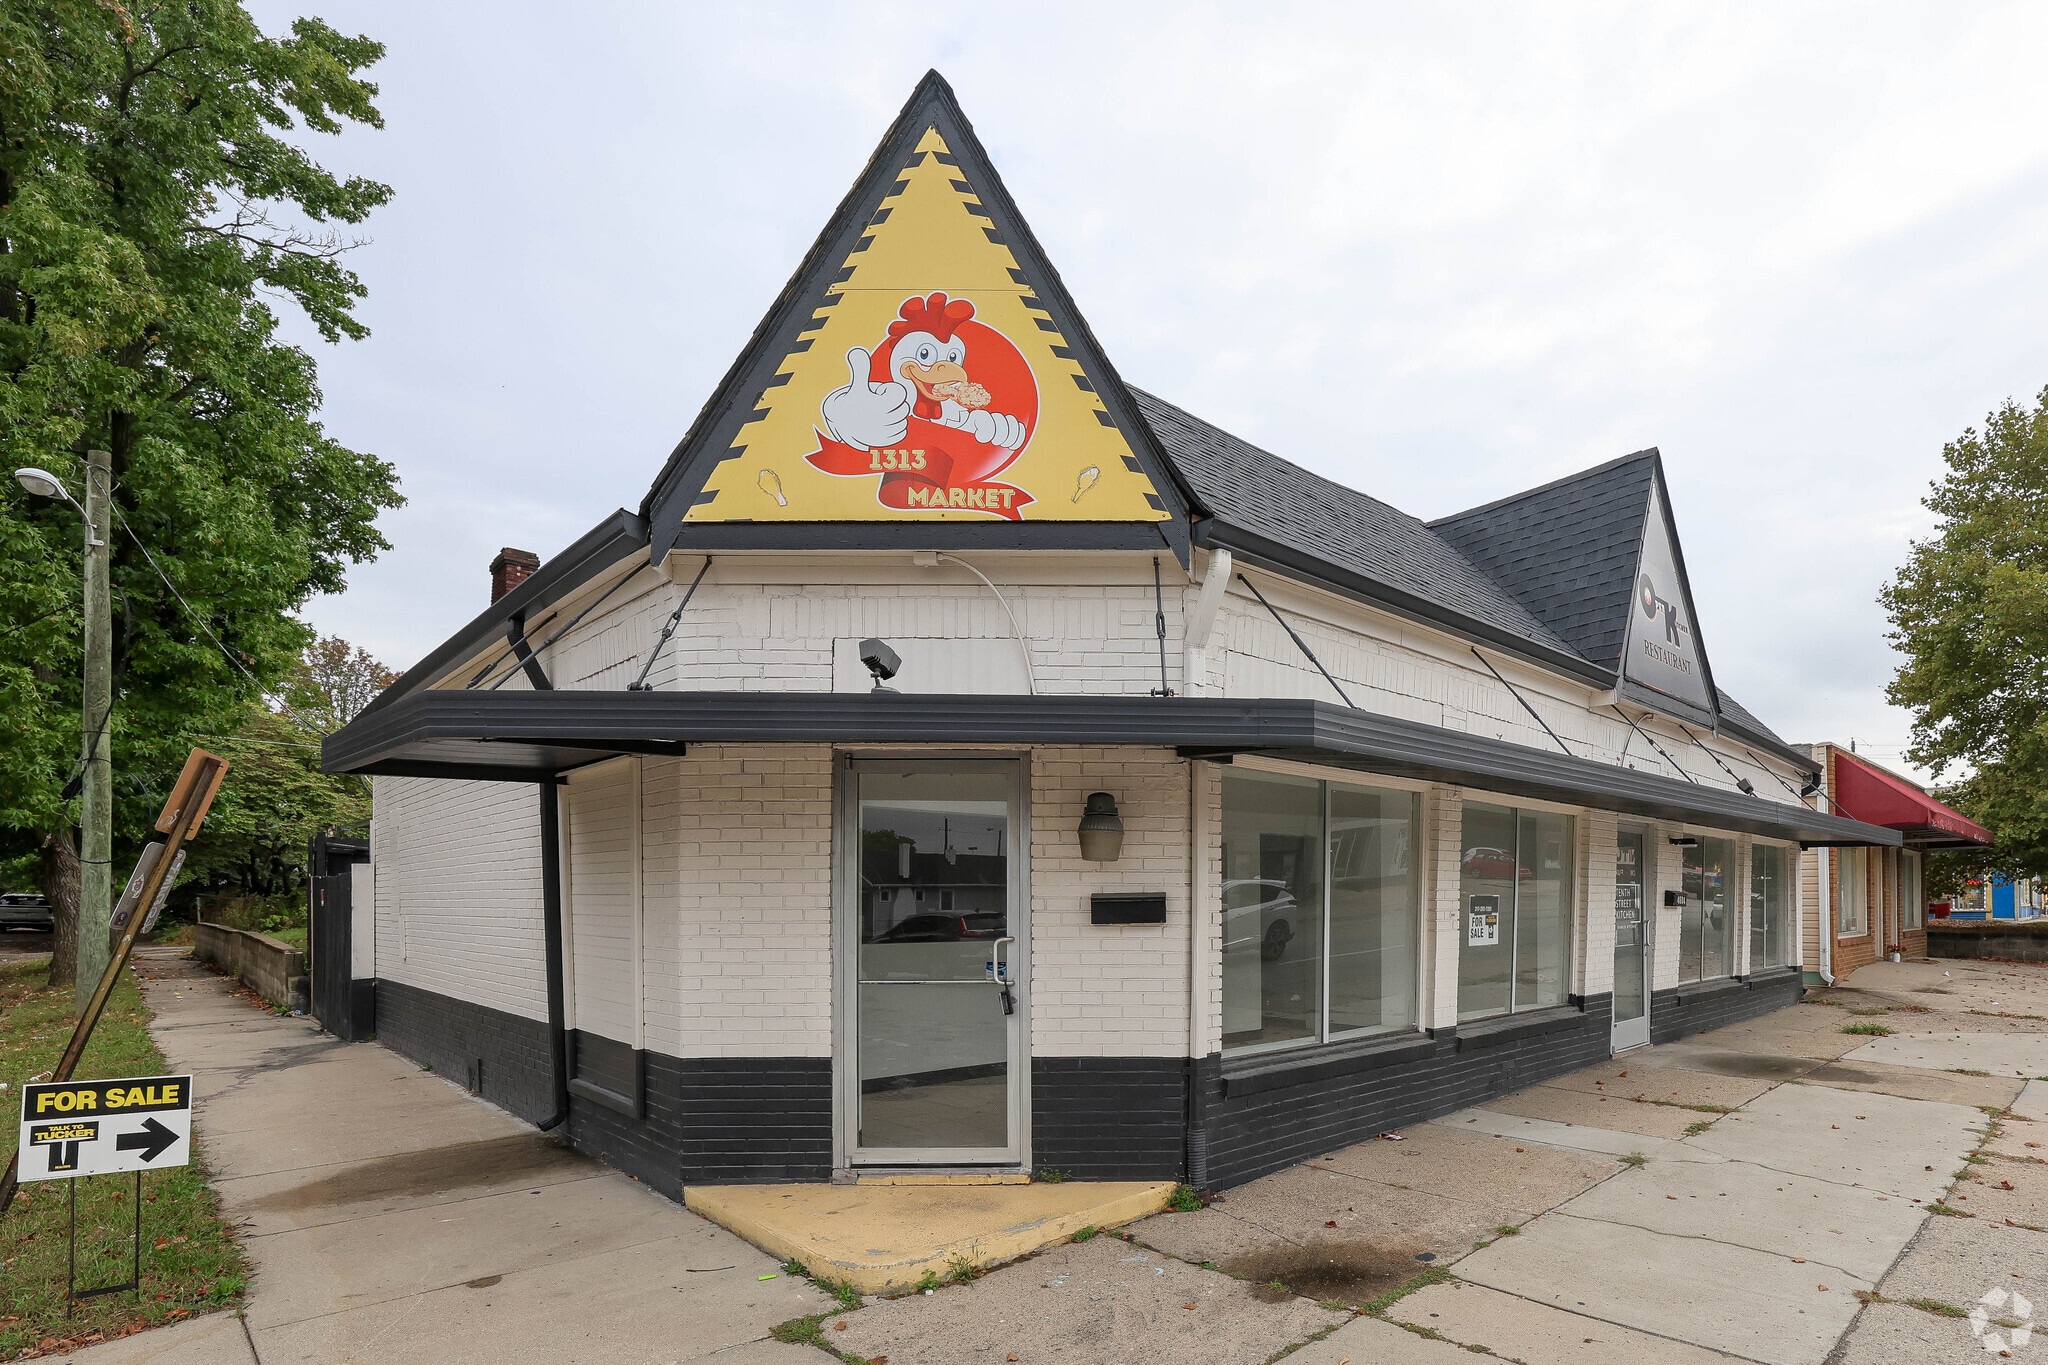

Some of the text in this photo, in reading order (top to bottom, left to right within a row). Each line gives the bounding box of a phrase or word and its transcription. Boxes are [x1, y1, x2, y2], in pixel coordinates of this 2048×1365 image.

[869, 449, 927, 470] 1313
[907, 487, 1016, 508] MARKET
[1643, 639, 1692, 675] RESTAURANT
[1615, 899, 1632, 908] STREET
[1472, 917, 1483, 927] FOR
[1470, 928, 1484, 938] SALE
[37, 1084, 180, 1113] FOR SALE
[34, 1128, 95, 1141] TUCKER
